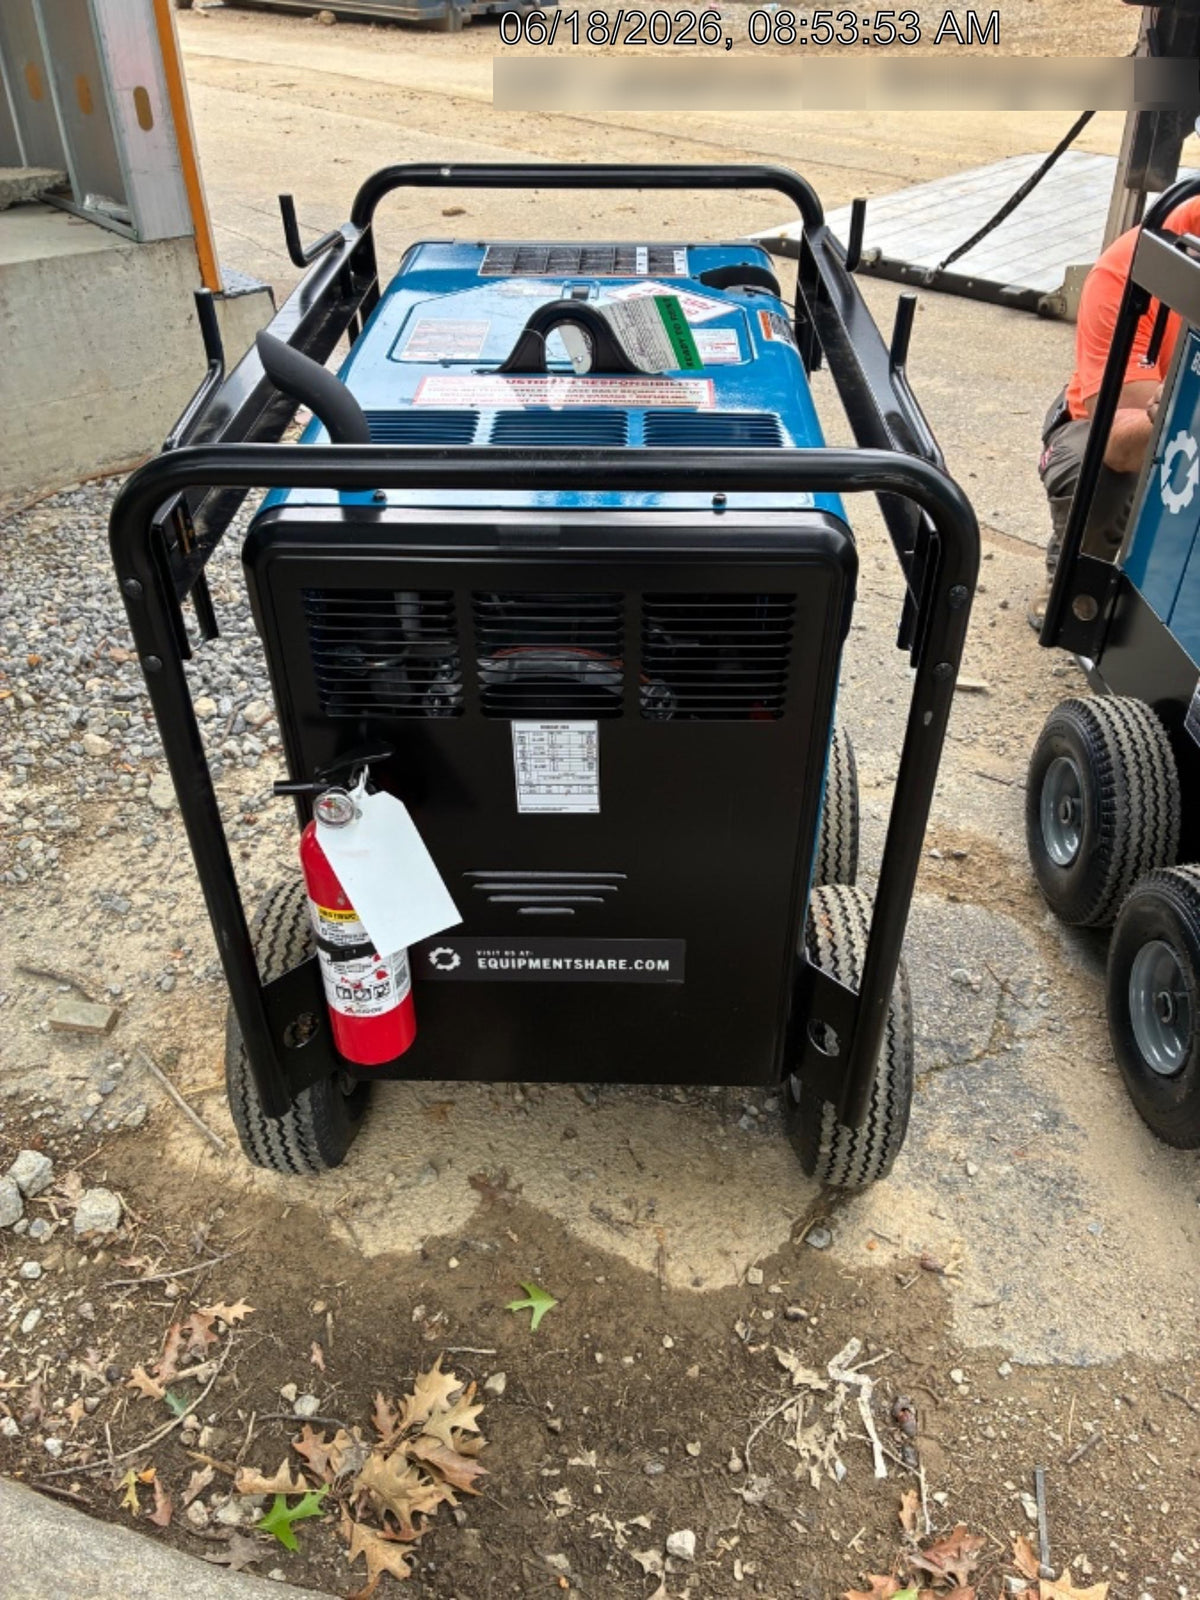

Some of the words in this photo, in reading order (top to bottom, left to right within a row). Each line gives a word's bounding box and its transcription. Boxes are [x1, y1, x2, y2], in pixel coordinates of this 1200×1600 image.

[678, 337, 695, 368] READY
[583, 379, 701, 388] RESPONSIBILITY
[477, 957, 671, 971] EQUIPMENTSHARE.COM
